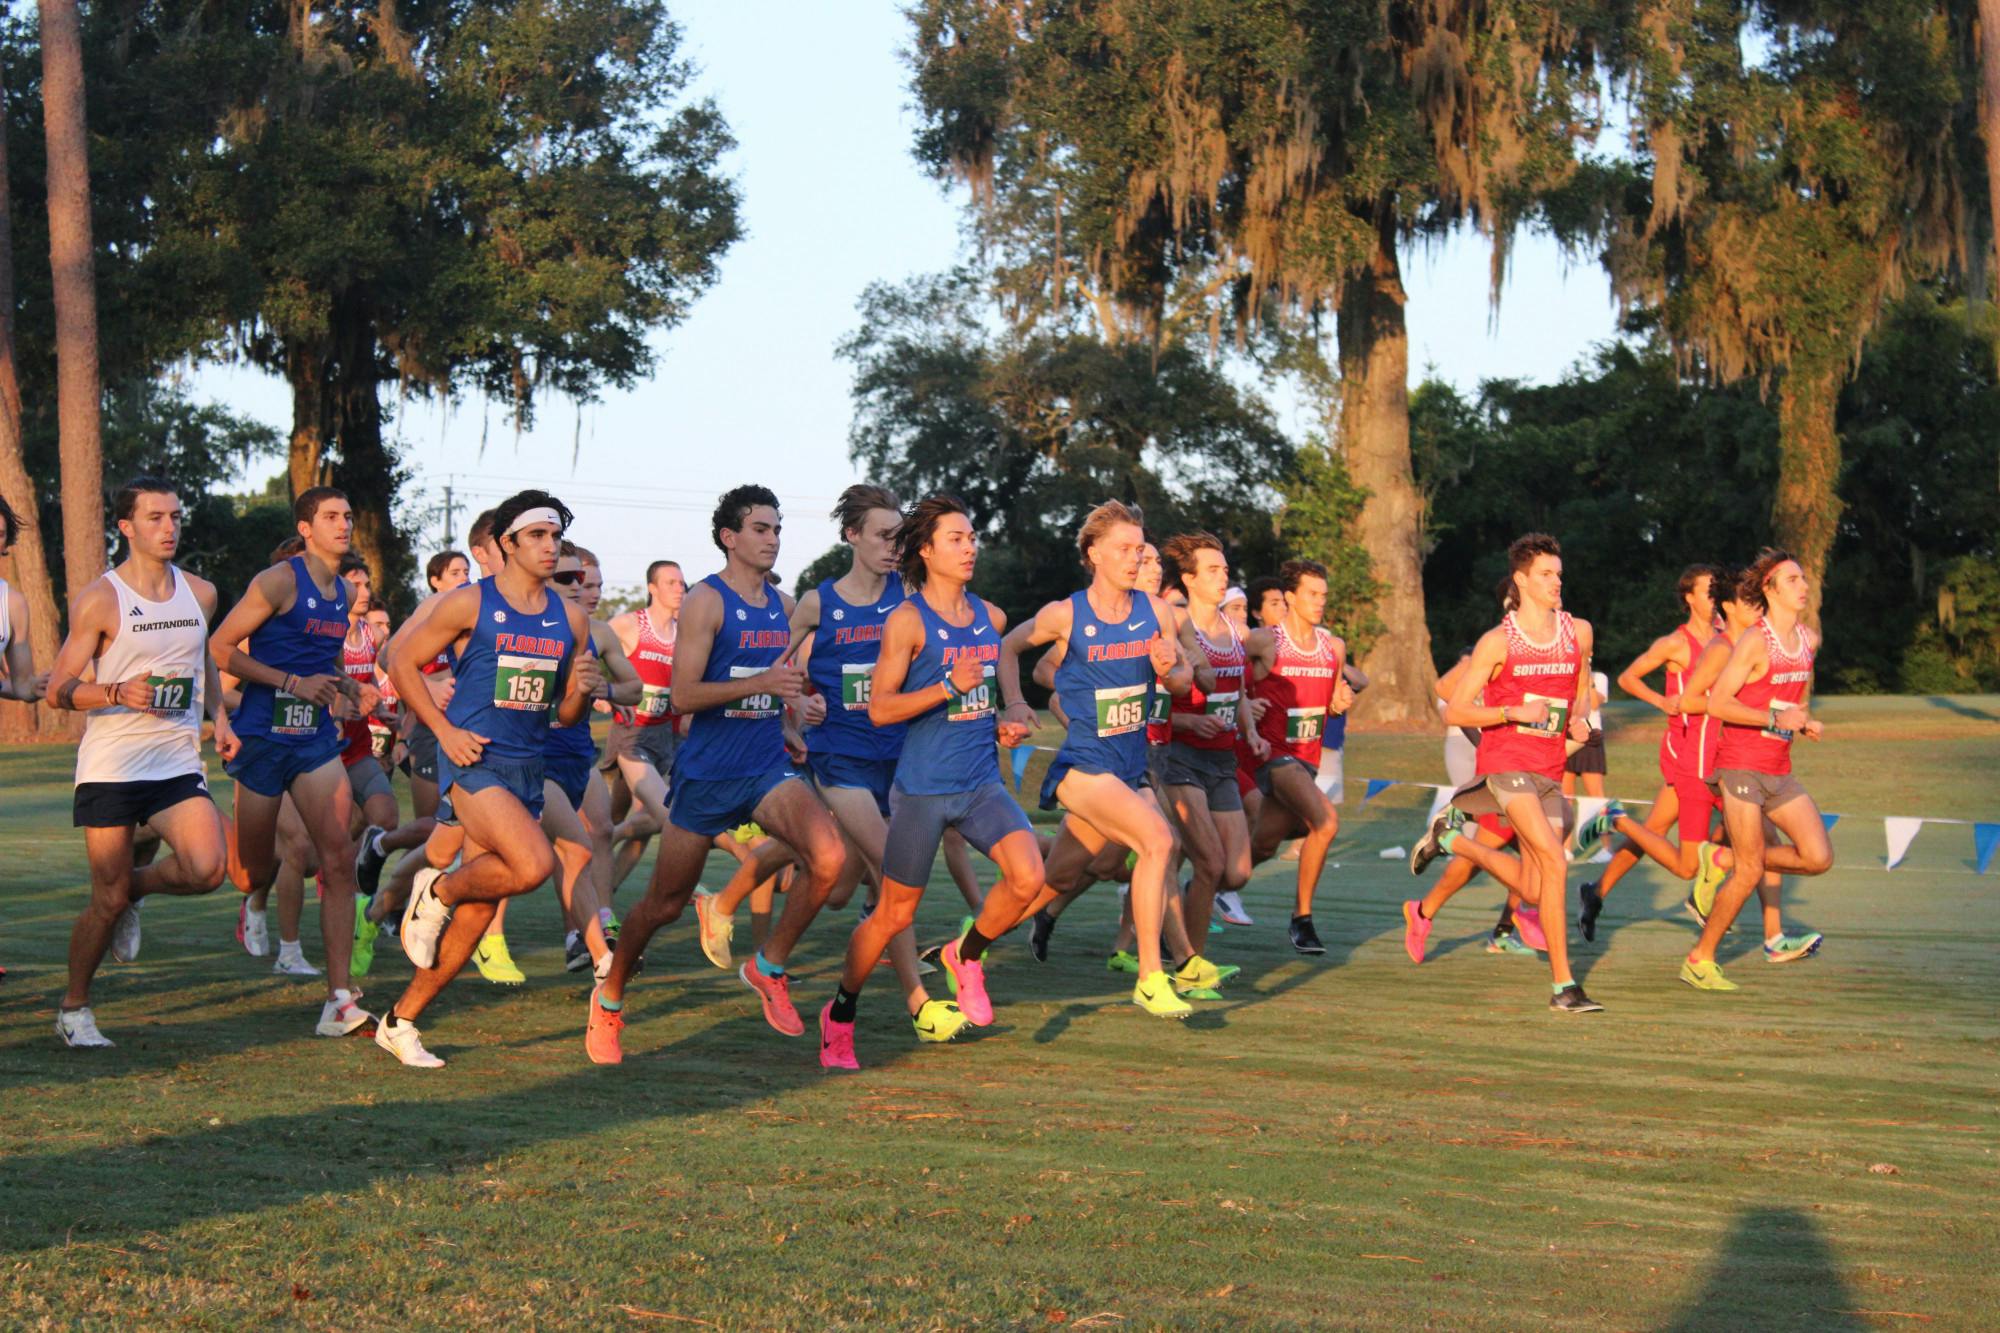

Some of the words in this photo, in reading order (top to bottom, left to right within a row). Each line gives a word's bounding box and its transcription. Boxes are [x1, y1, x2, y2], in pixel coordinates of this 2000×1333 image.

[132, 618, 200, 632] CHATTANOOGA
[835, 624, 883, 644] FLORI
[496, 633, 564, 657] FLORIDA
[1281, 666, 1334, 678] SOUTHERN
[1512, 663, 1575, 677] SOUTHERN
[154, 684, 184, 708] 112
[508, 675, 545, 702] 153
[852, 680, 871, 703] 15
[284, 704, 313, 727] 156
[1106, 700, 1142, 727] 465
[1296, 719, 1318, 738] 176
